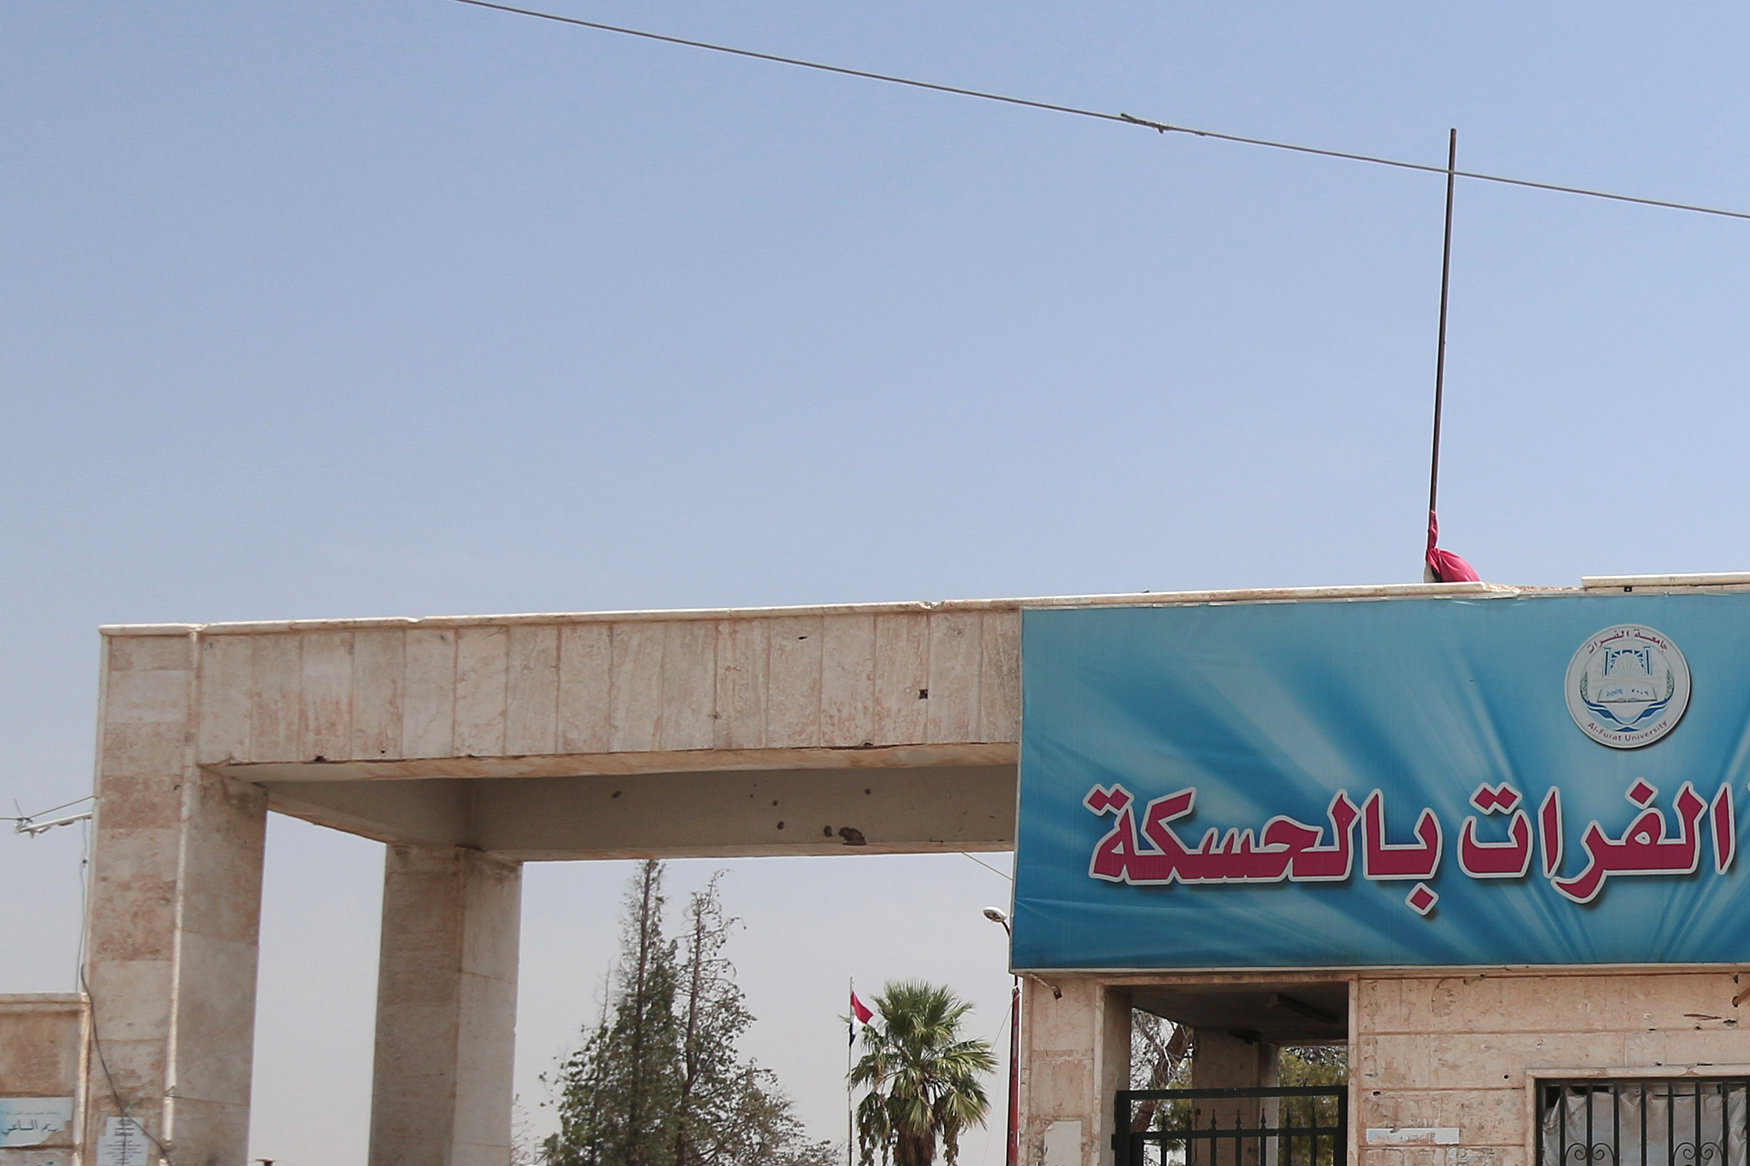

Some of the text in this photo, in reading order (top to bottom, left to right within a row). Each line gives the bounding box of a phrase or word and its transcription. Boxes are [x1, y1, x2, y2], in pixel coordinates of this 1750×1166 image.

[1587, 628, 1668, 655] جامعة الفرات
[1588, 720, 1668, 742] Al-Furat University
[1083, 782, 1442, 915] بالحسكة
[1457, 779, 1735, 904] الفرات
